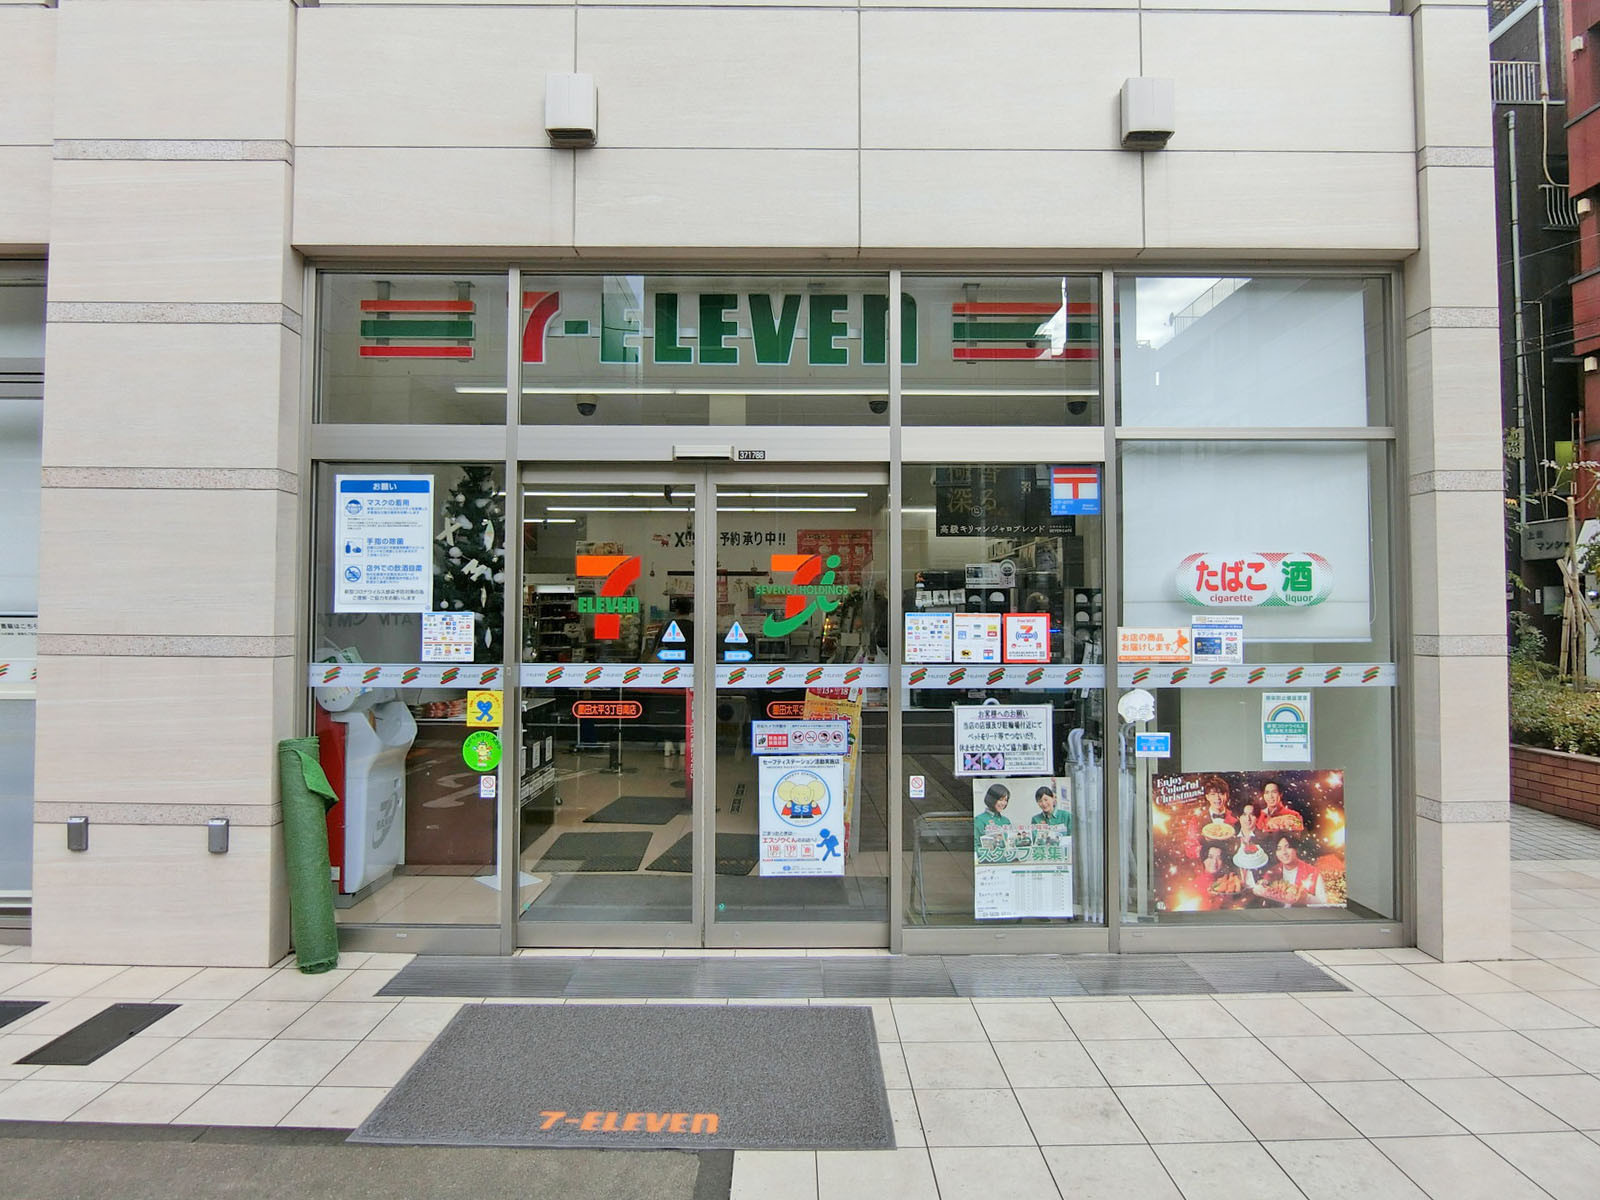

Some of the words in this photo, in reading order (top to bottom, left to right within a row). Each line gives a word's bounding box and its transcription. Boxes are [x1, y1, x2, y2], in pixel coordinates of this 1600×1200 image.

[372, 482, 397, 490] お願い
[940, 525, 1046, 534] 高級キリマンジャロブレンド
[1196, 560, 1267, 592] たばこ
[1281, 561, 1312, 592] 酒
[799, 584, 849, 595] HOLDINGS
[1210, 594, 1253, 603] cigarette
[1286, 594, 1313, 603] liquor
[1121, 633, 1164, 641] お店の商品
[978, 709, 1029, 718] お客様へのお願い
[1157, 776, 1182, 788] Enjoy
[1160, 780, 1199, 795] Colorful
[1155, 786, 1205, 804] Christmas!
[979, 847, 1068, 862] スタッフ募集!
